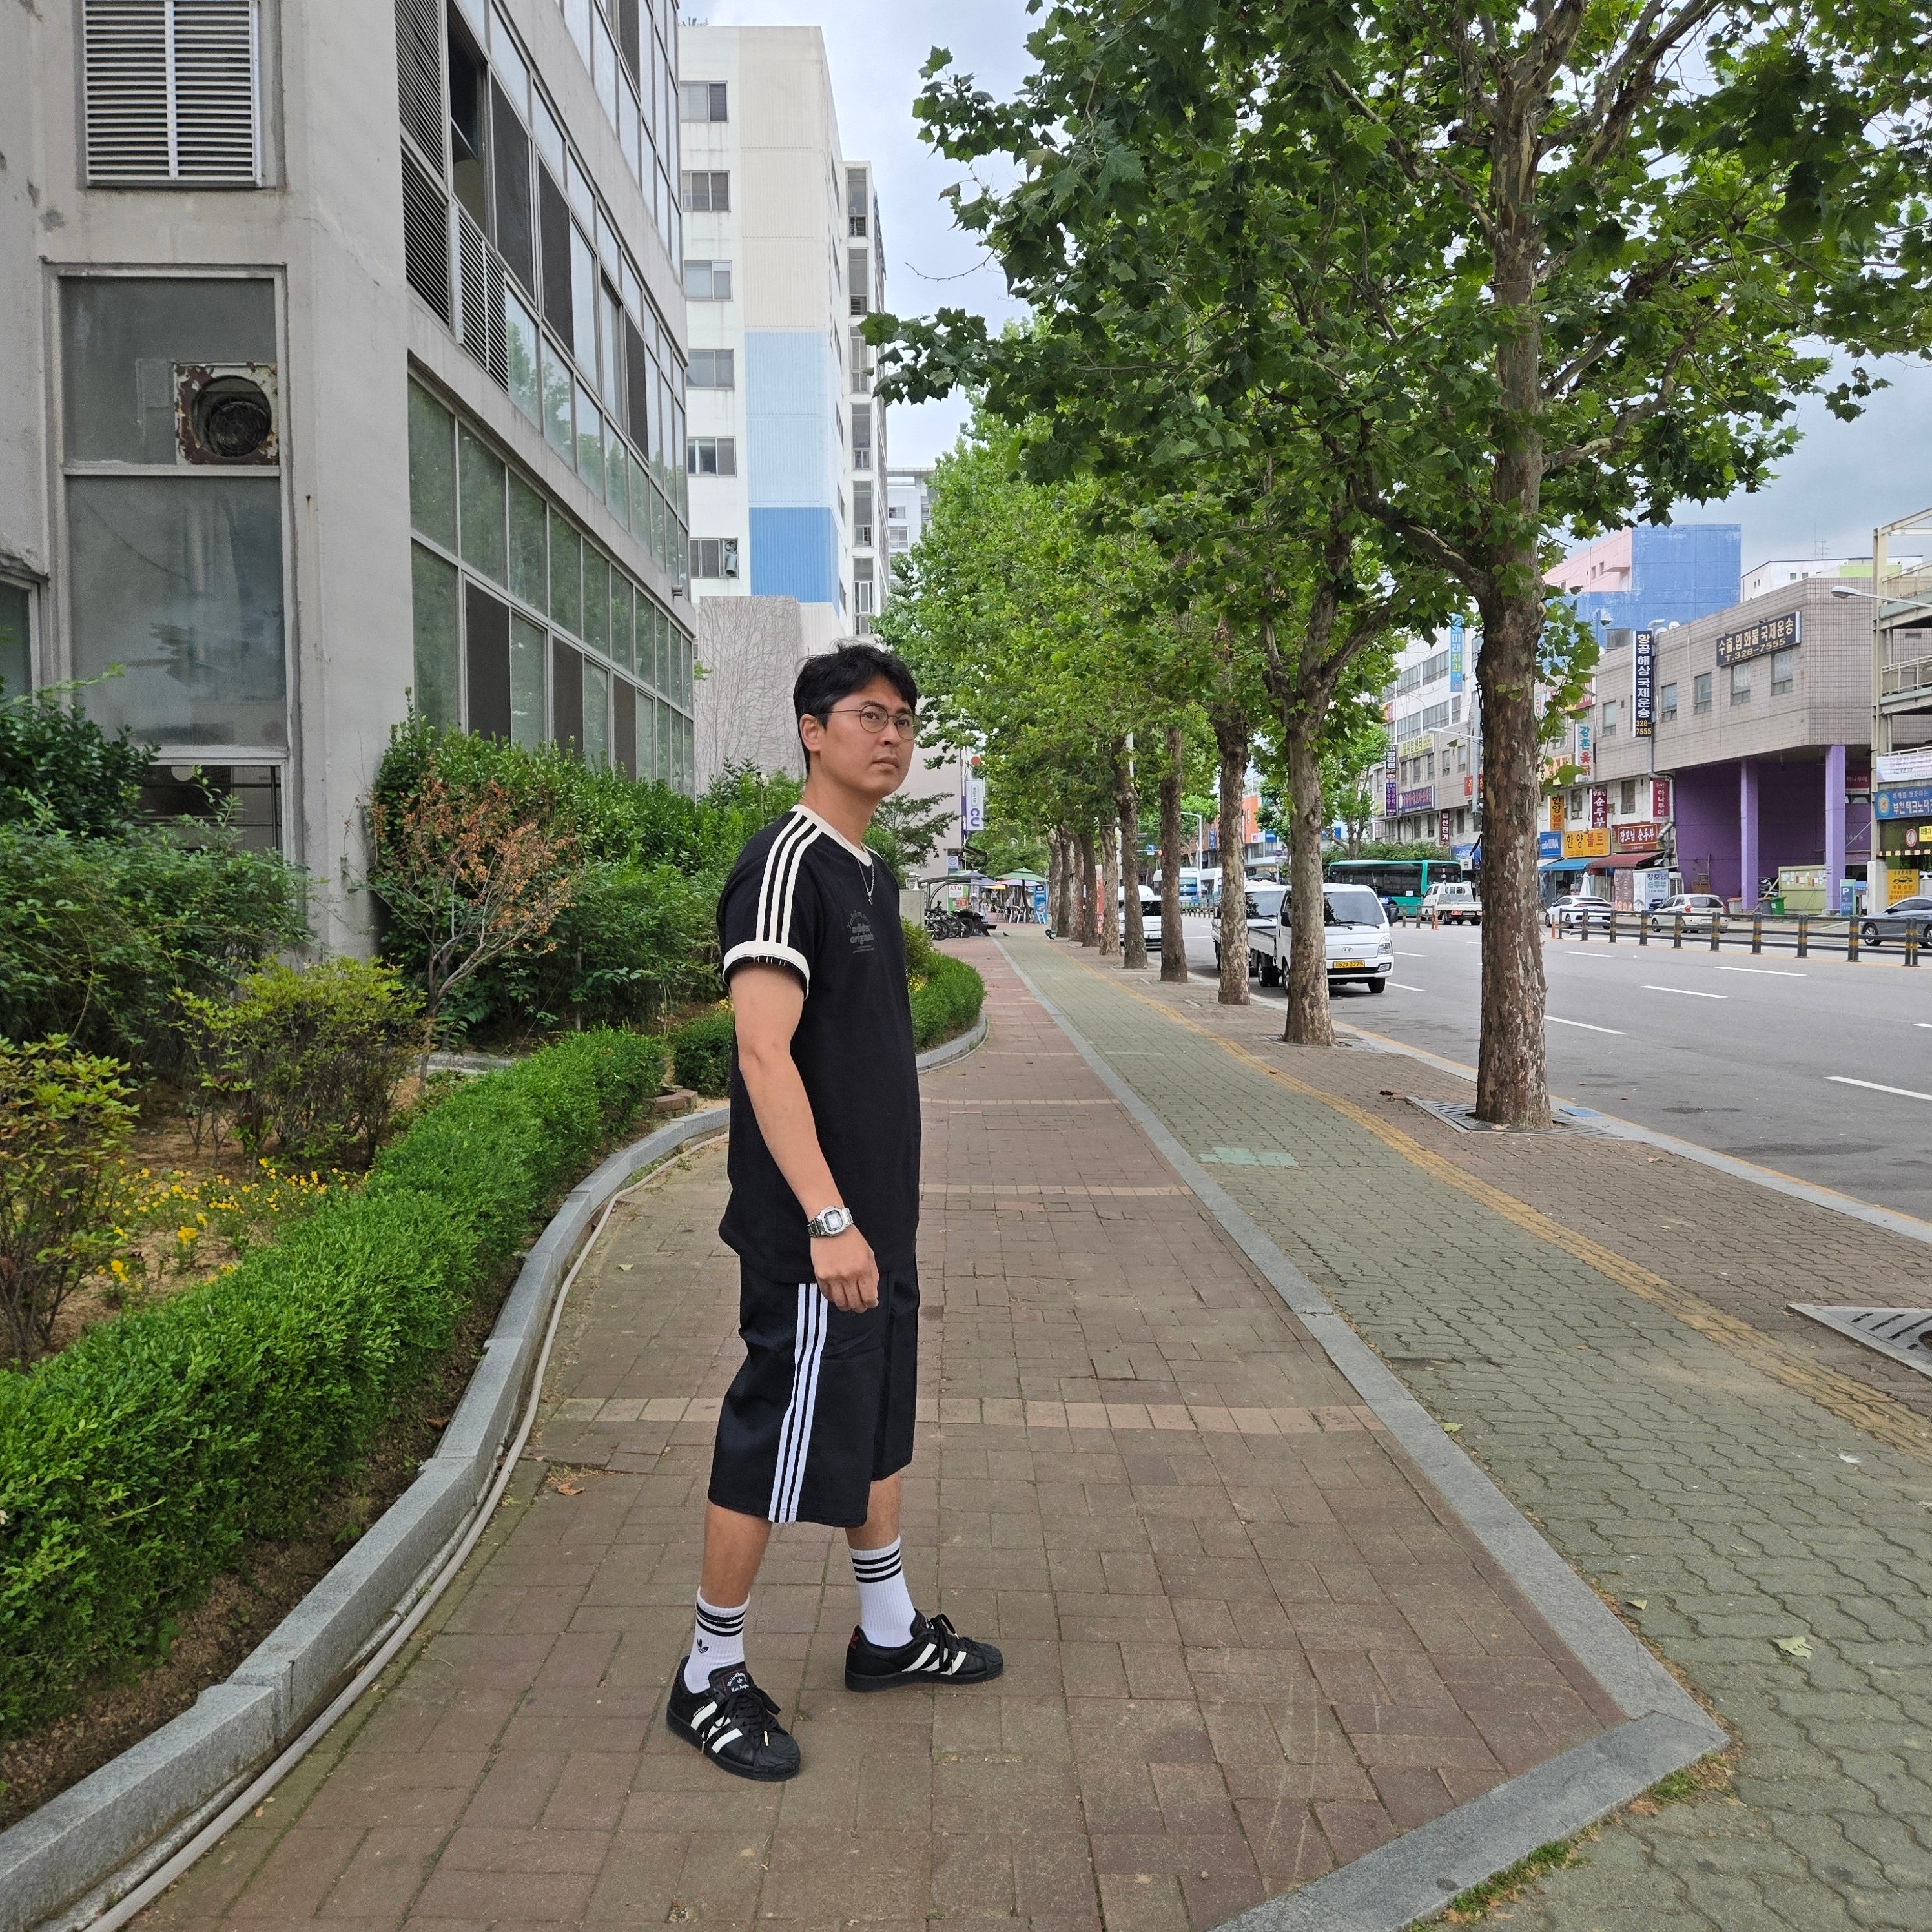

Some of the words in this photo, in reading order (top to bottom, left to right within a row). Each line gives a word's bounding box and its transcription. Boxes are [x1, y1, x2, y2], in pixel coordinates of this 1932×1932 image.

[1744, 628, 1759, 647] 화물
[1761, 617, 1793, 642] 국제운송
[1638, 634, 1651, 676] 항공해상
[1725, 638, 1785, 662] T.328-7555
[1637, 677, 1650, 718] 국제운송
[1657, 789, 1665, 816] 하나투어
[1893, 799, 1932, 815] 부천테크노파
[971, 808, 980, 827] CU
[1637, 827, 1654, 841] 순두부
